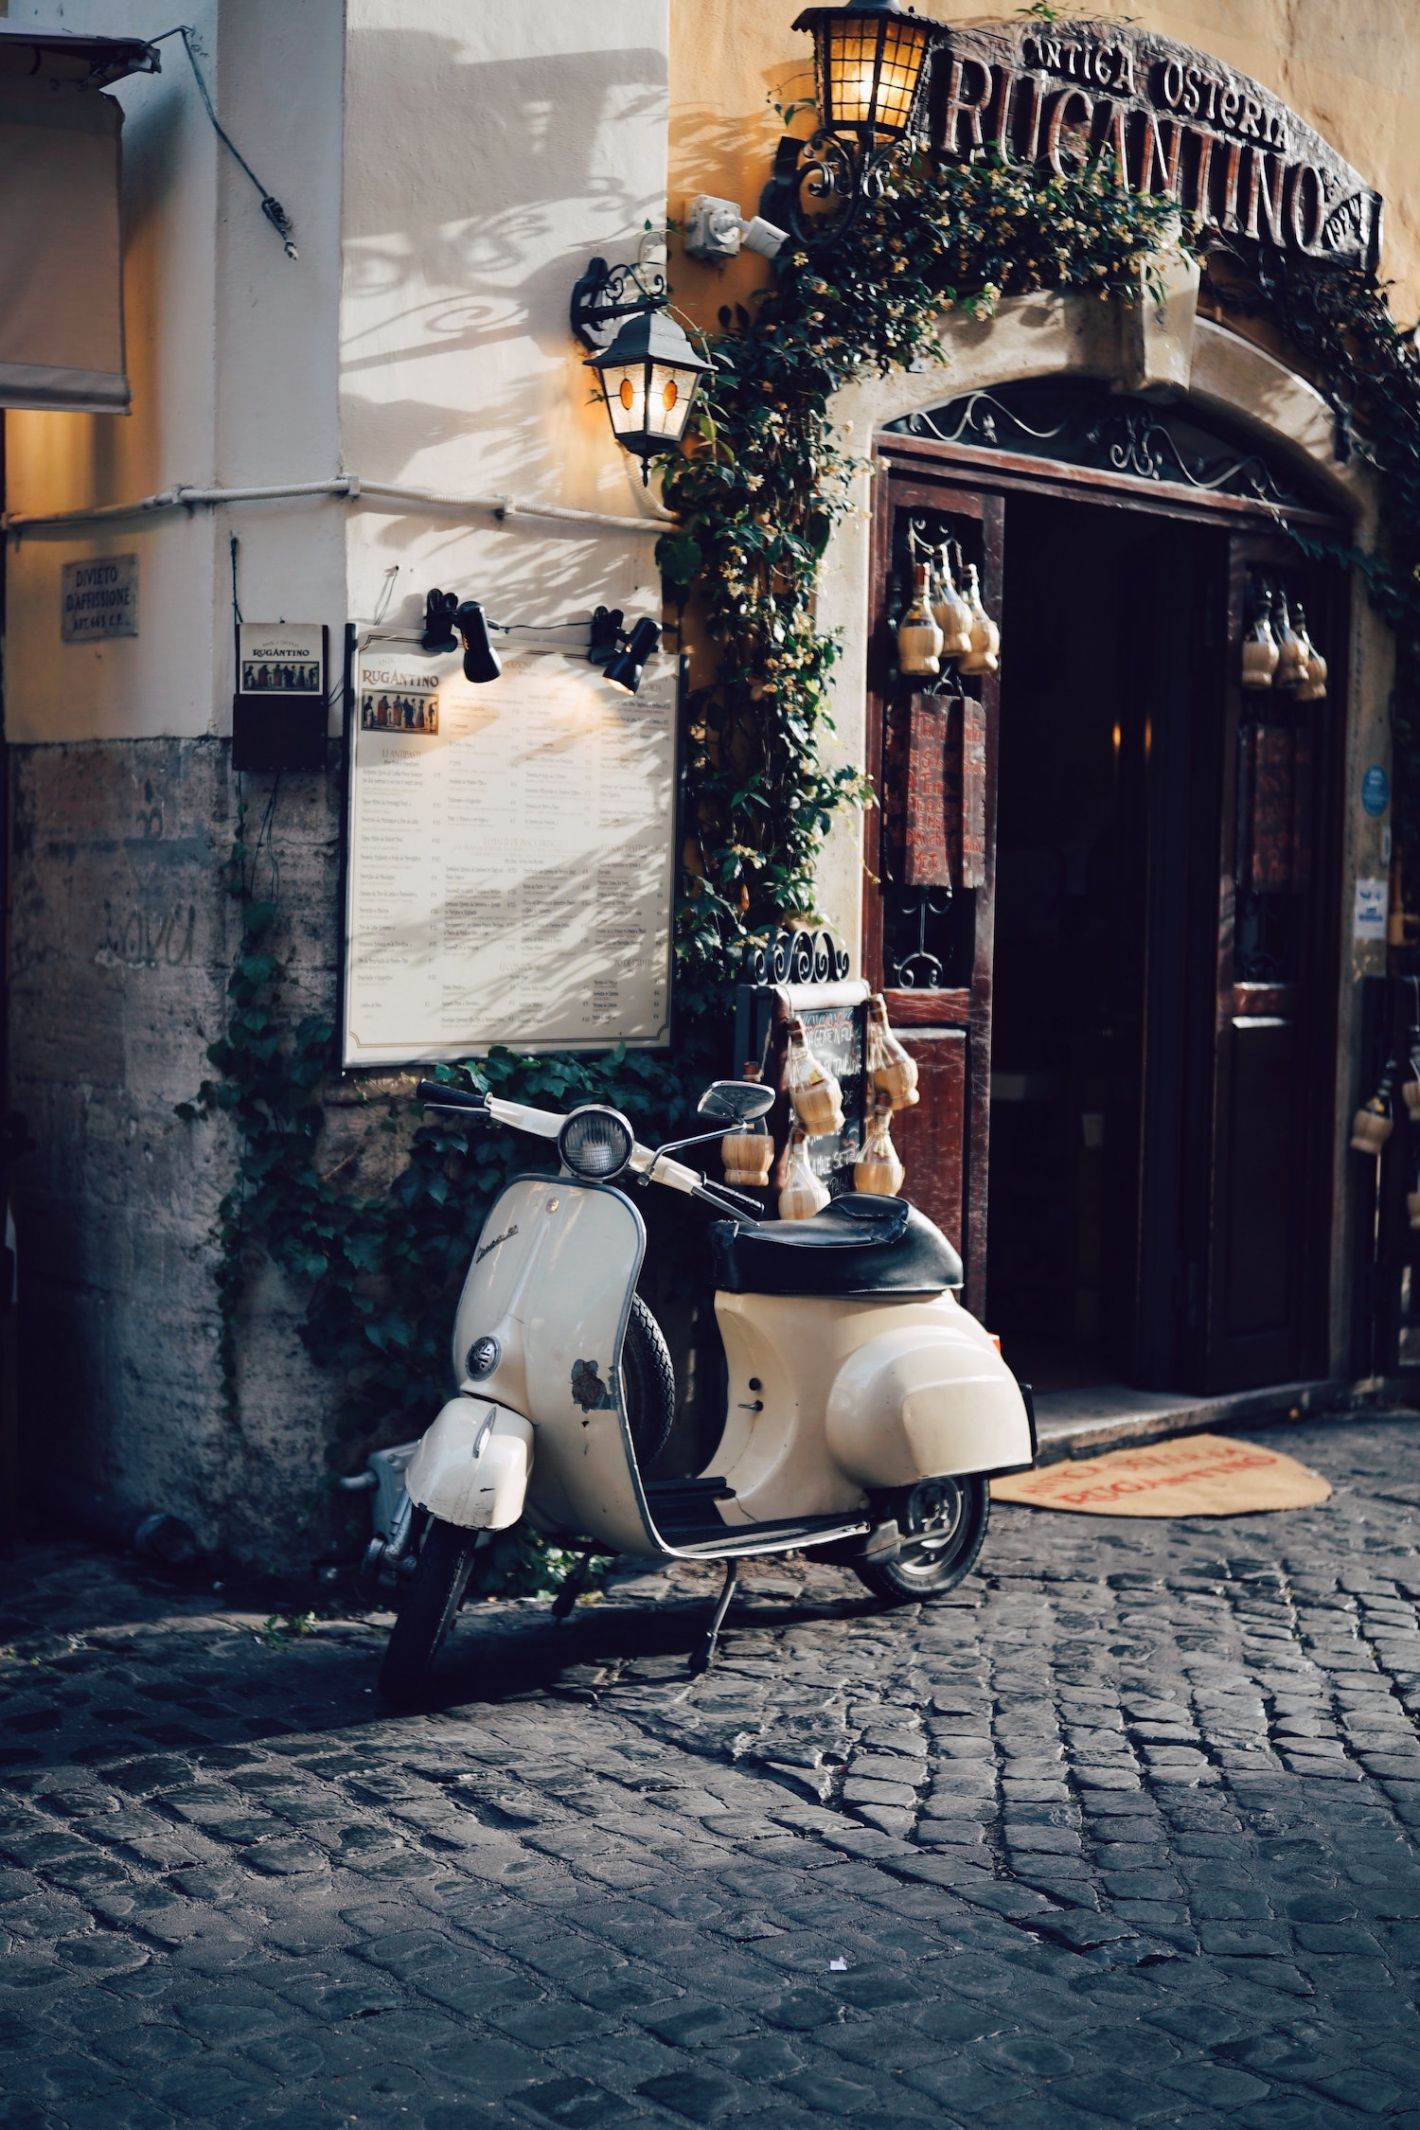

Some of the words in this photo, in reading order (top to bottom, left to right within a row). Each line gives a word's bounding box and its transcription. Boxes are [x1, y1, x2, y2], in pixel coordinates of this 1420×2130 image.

[941, 50, 1326, 256] RUGANTINO
[76, 567, 118, 587] DIVIETO
[252, 648, 310, 657] RUGANTINO
[362, 668, 440, 688] RUGANTINO
